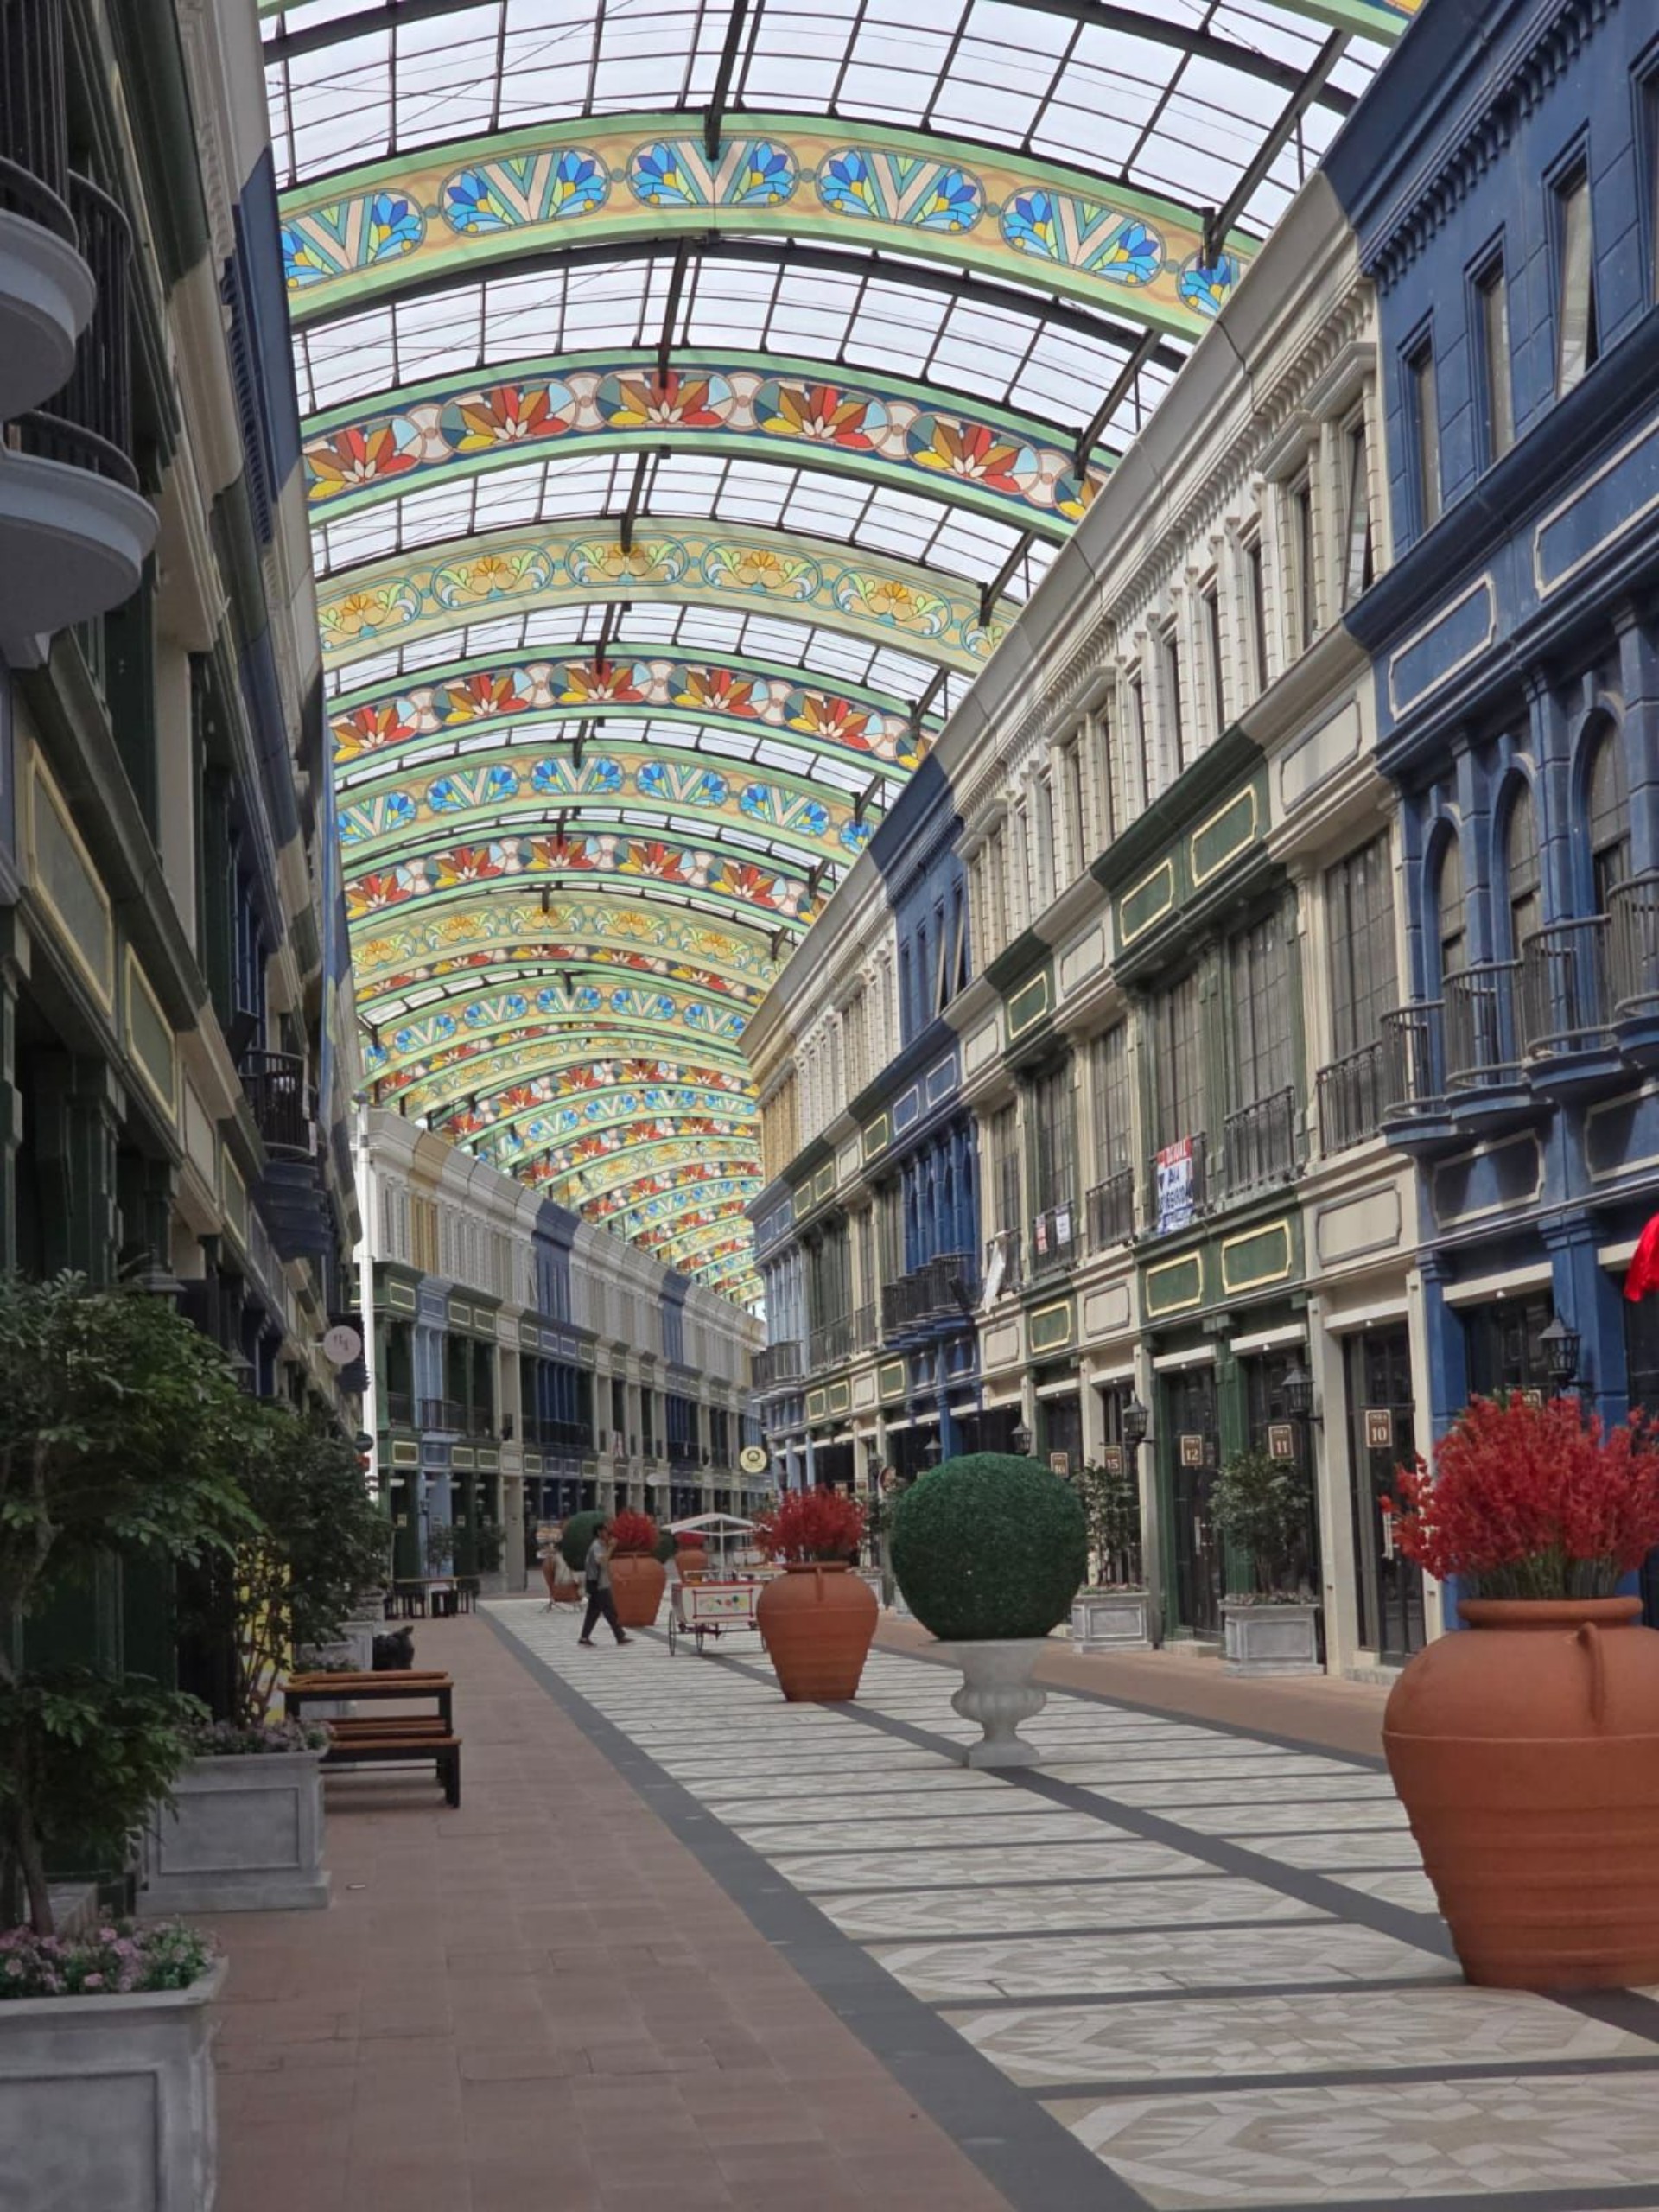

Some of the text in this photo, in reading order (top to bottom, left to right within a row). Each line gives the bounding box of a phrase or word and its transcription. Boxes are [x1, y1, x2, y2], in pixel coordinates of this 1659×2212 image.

[1372, 1427, 1387, 1441] 10
[1276, 1440, 1287, 1453] 11
[1186, 1448, 1198, 1460] 12
